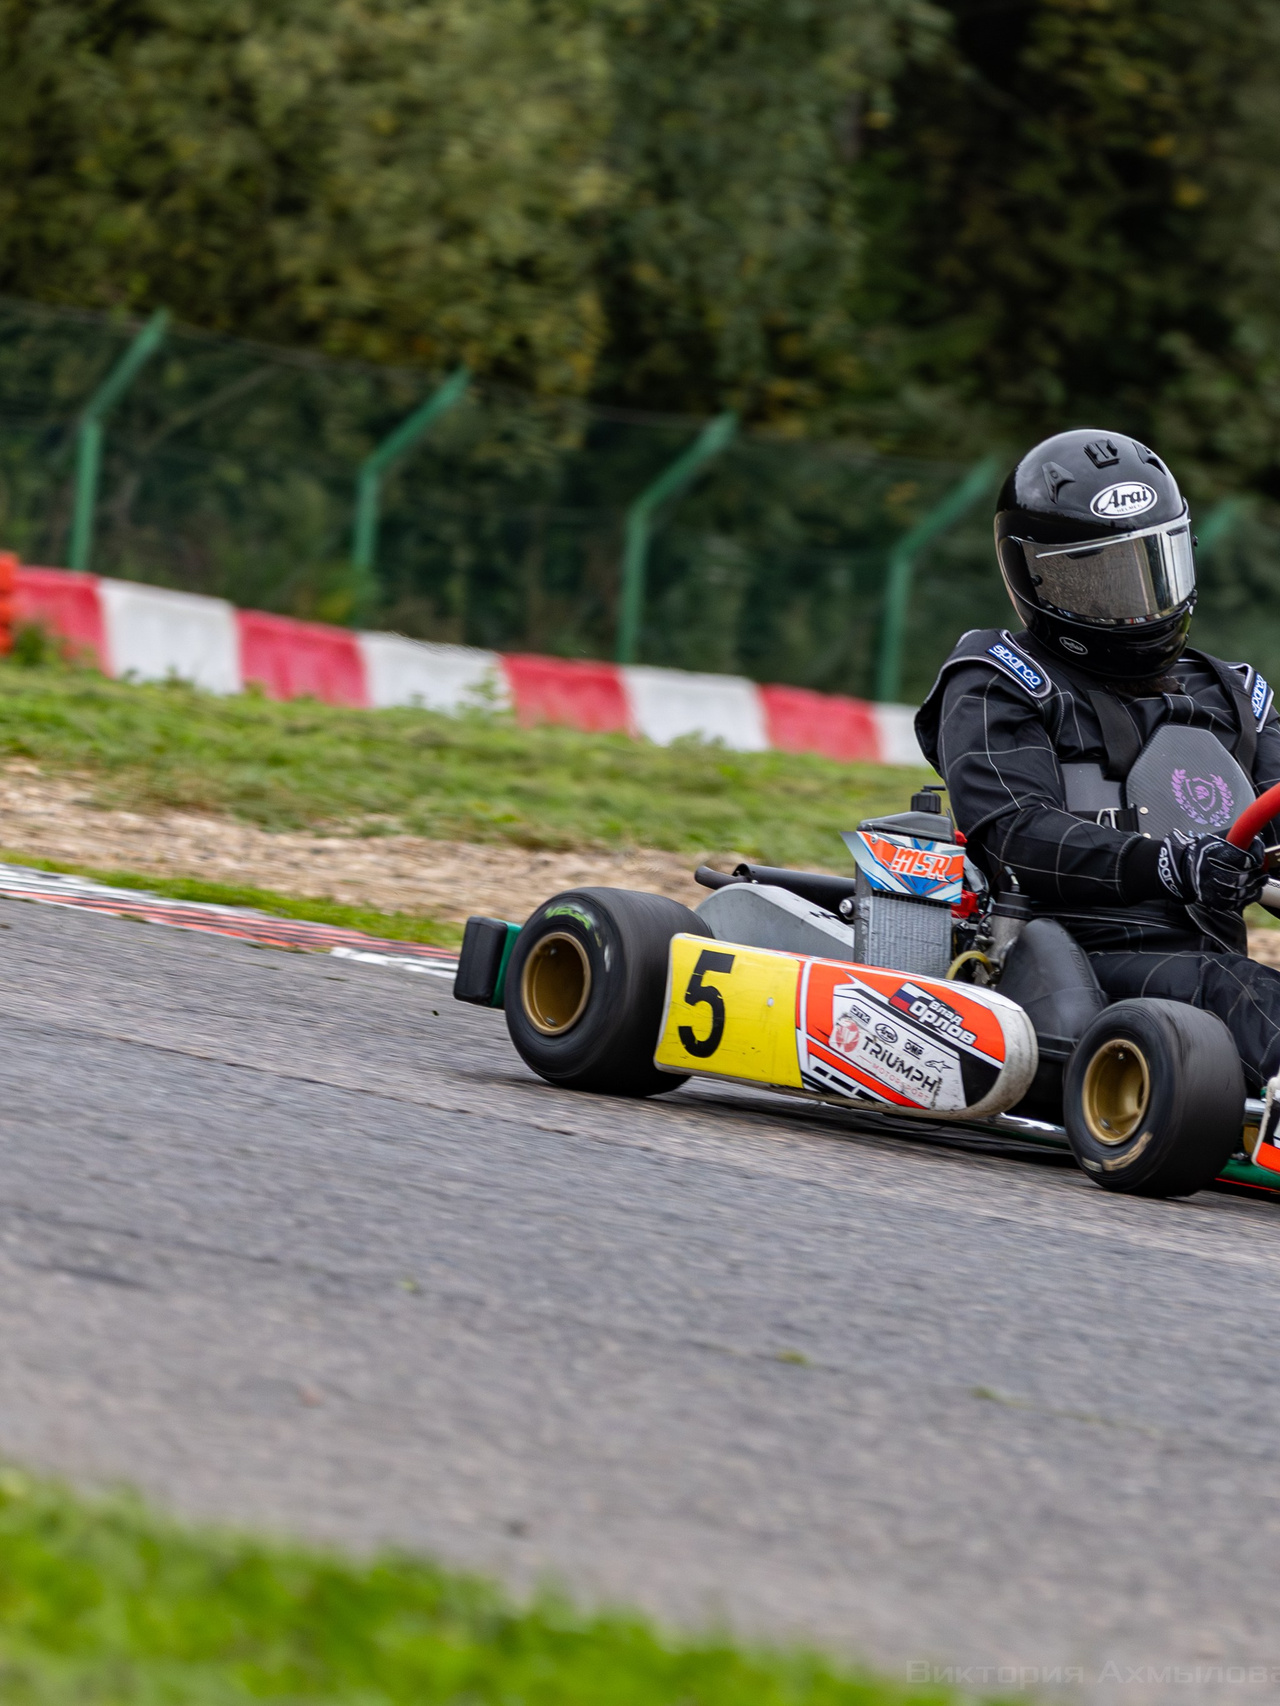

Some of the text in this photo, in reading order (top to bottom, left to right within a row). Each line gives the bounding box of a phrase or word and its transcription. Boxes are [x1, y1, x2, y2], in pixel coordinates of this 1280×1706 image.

[1100, 485, 1148, 512] Arai
[992, 644, 1041, 686] sparco
[1158, 846, 1182, 894] sparc
[678, 949, 736, 1058] 5
